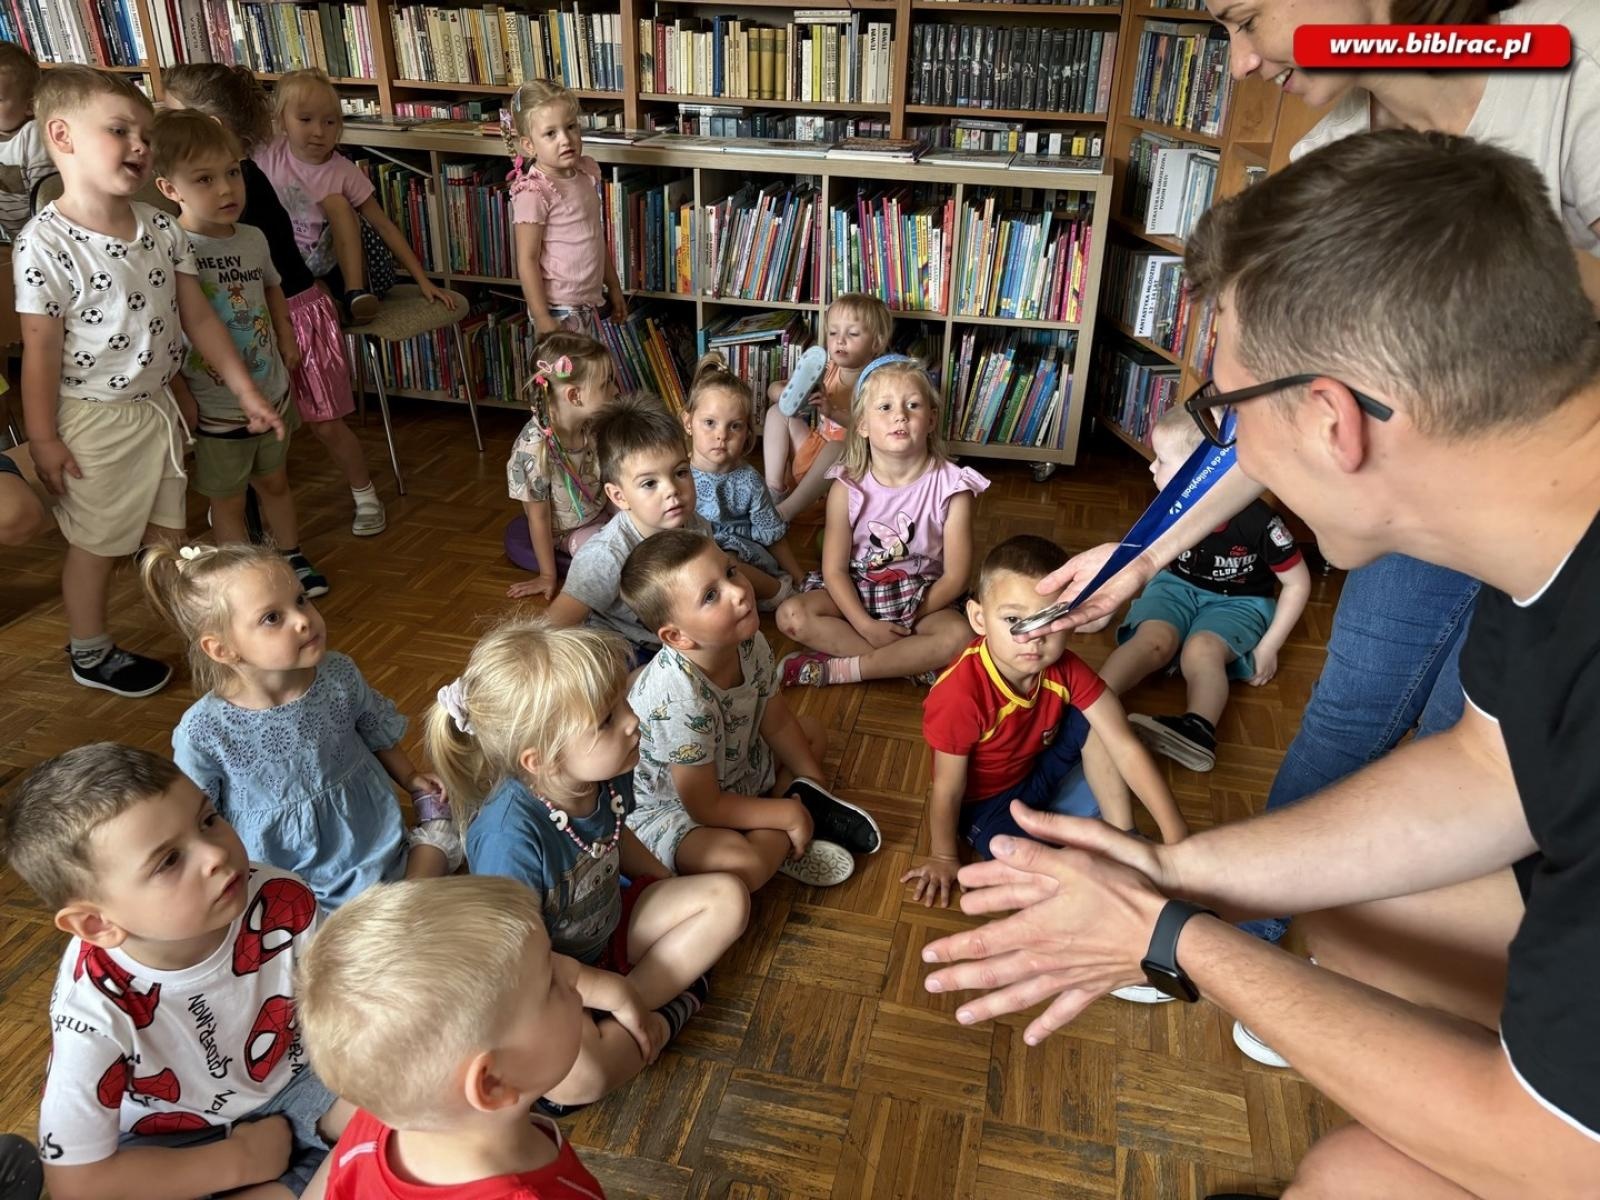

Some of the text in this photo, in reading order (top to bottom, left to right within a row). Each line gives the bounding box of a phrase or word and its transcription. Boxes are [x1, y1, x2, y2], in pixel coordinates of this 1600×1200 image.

[1150, 195, 1160, 230] LITERATURA
[196, 256, 241, 271] HEEKY
[1139, 261, 1157, 334] FANTASTYKA MŁODZIEŻ
[1211, 456, 1221, 466] de
[1181, 465, 1215, 498] Volleyball
[188, 993, 233, 1079] SPIDER-MAN
